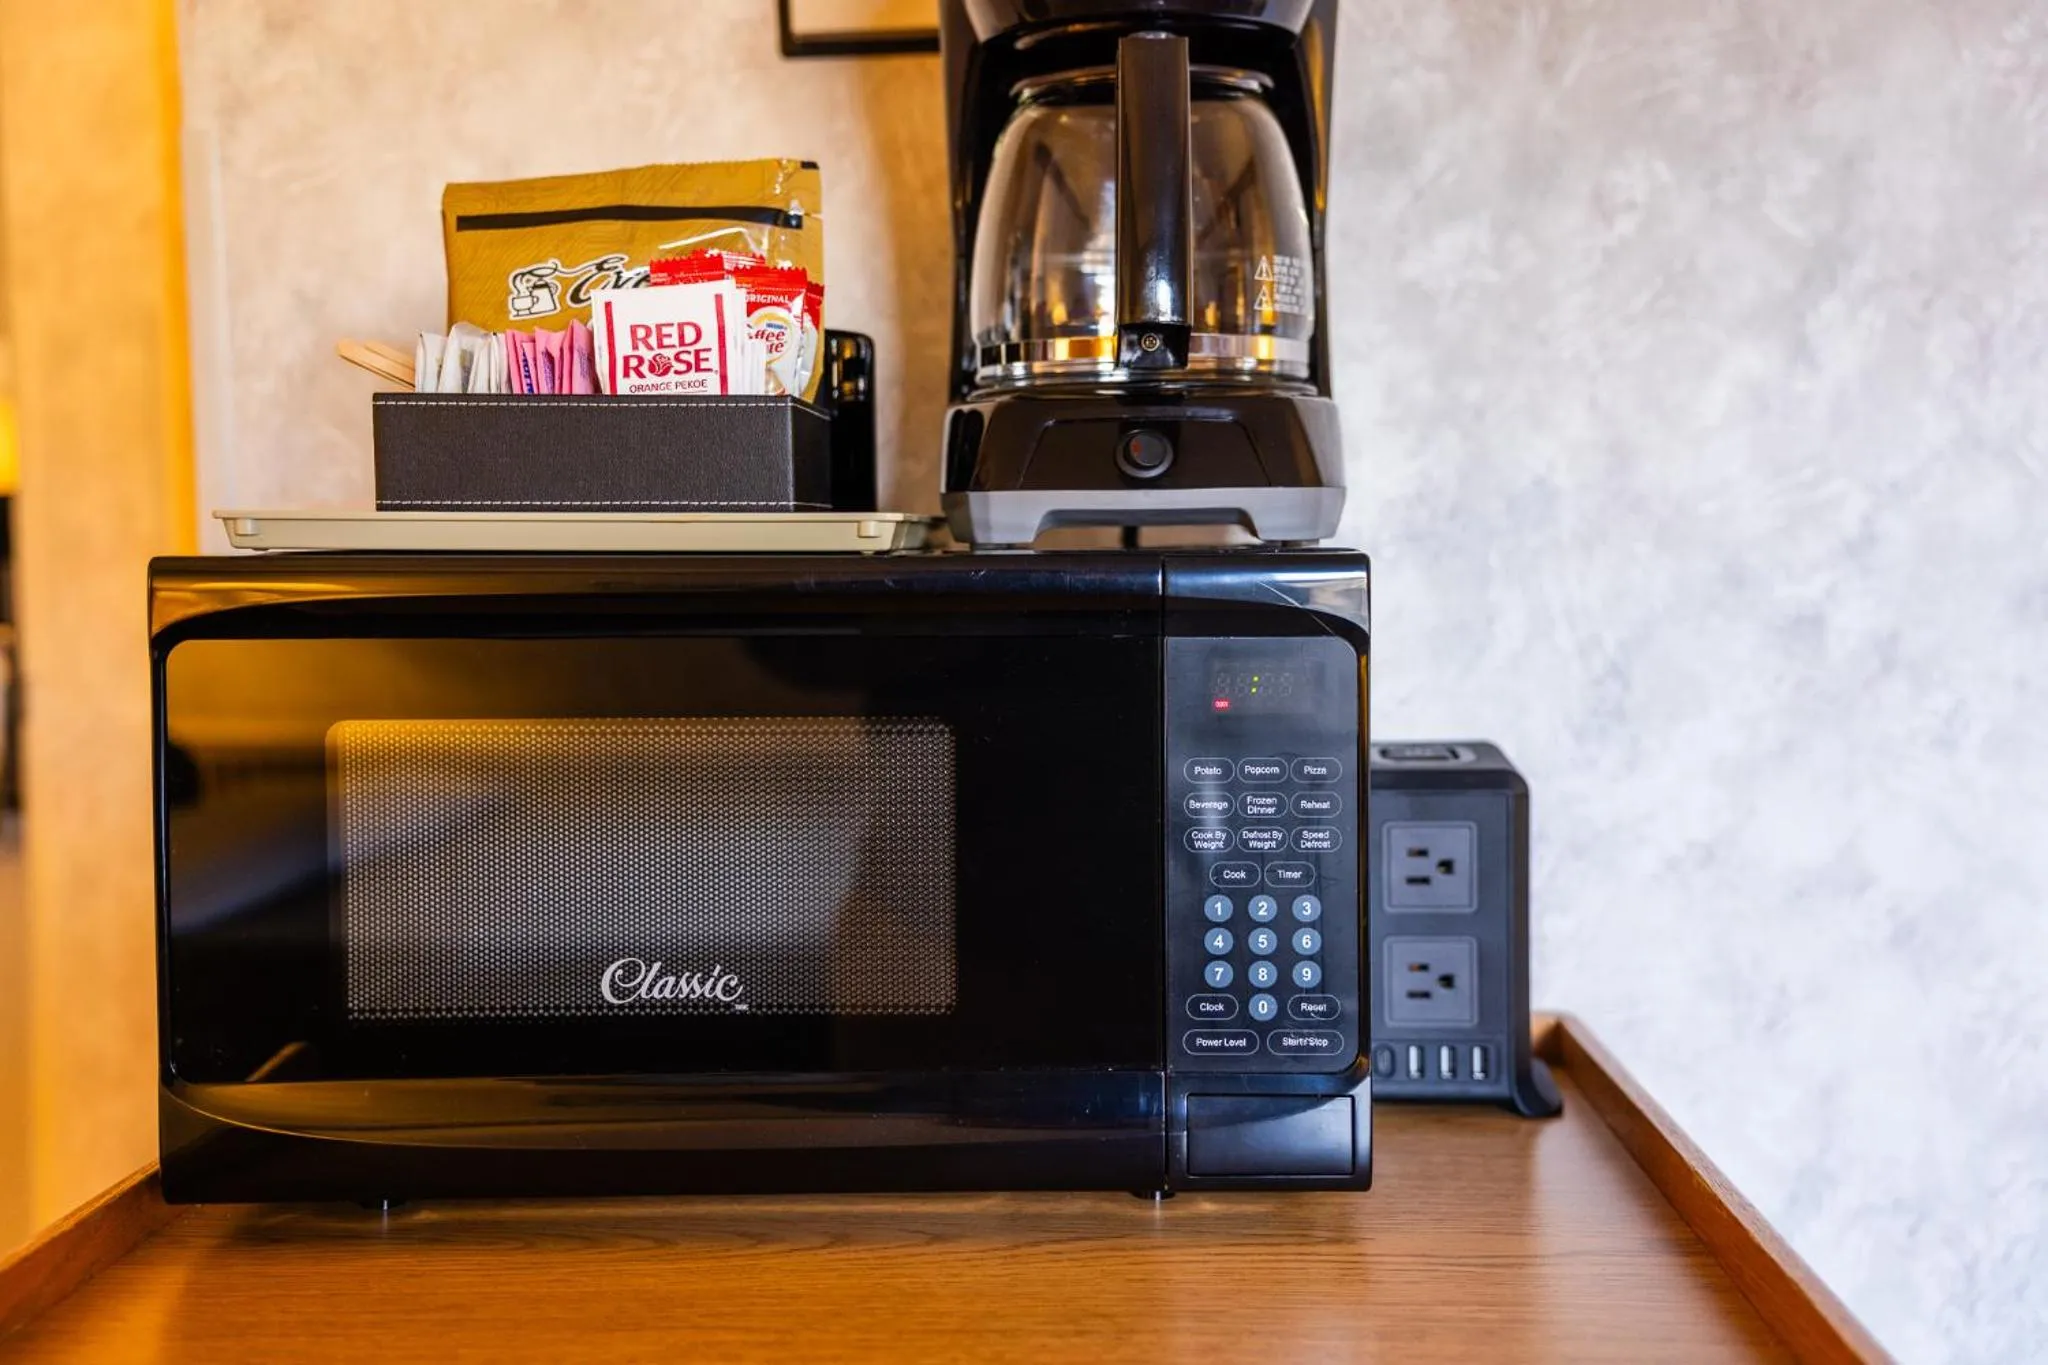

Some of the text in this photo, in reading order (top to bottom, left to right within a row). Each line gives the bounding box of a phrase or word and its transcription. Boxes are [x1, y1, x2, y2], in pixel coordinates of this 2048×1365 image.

[630, 322, 702, 351] RED
[622, 348, 713, 379] ROSE
[629, 379, 709, 394] ORANGE PEKOE
[1194, 765, 1223, 776] Potato
[1244, 765, 1280, 776] Popcorn
[1303, 765, 1328, 776] Pizza
[1189, 800, 1228, 810] Beverage
[1247, 796, 1278, 806] Frozen
[1300, 799, 1331, 809] Reheat
[1247, 805, 1277, 815] Dinner
[1191, 830, 1227, 843] Cook By
[1242, 830, 1283, 843] Defrost By
[1302, 830, 1330, 842] Speed
[1194, 840, 1225, 851] Weight
[1248, 840, 1277, 851] Weight
[1300, 840, 1331, 850] Defrost
[1223, 869, 1247, 880] Cook
[1277, 869, 1302, 880] Timer
[1214, 902, 1222, 915] 1
[1258, 902, 1268, 915] 2
[1302, 902, 1312, 915] 3
[1214, 935, 1224, 948] 4
[1258, 935, 1268, 948] 5
[1302, 935, 1312, 948] 6
[601, 957, 744, 1004] Classic
[1214, 968, 1224, 981] 7
[1258, 968, 1268, 981] 8
[1302, 968, 1312, 981] 9
[1199, 1002, 1225, 1012] Clock
[1258, 1001, 1268, 1014] 0
[1300, 1002, 1327, 1013] Reset
[1196, 1036, 1247, 1048] Power Level
